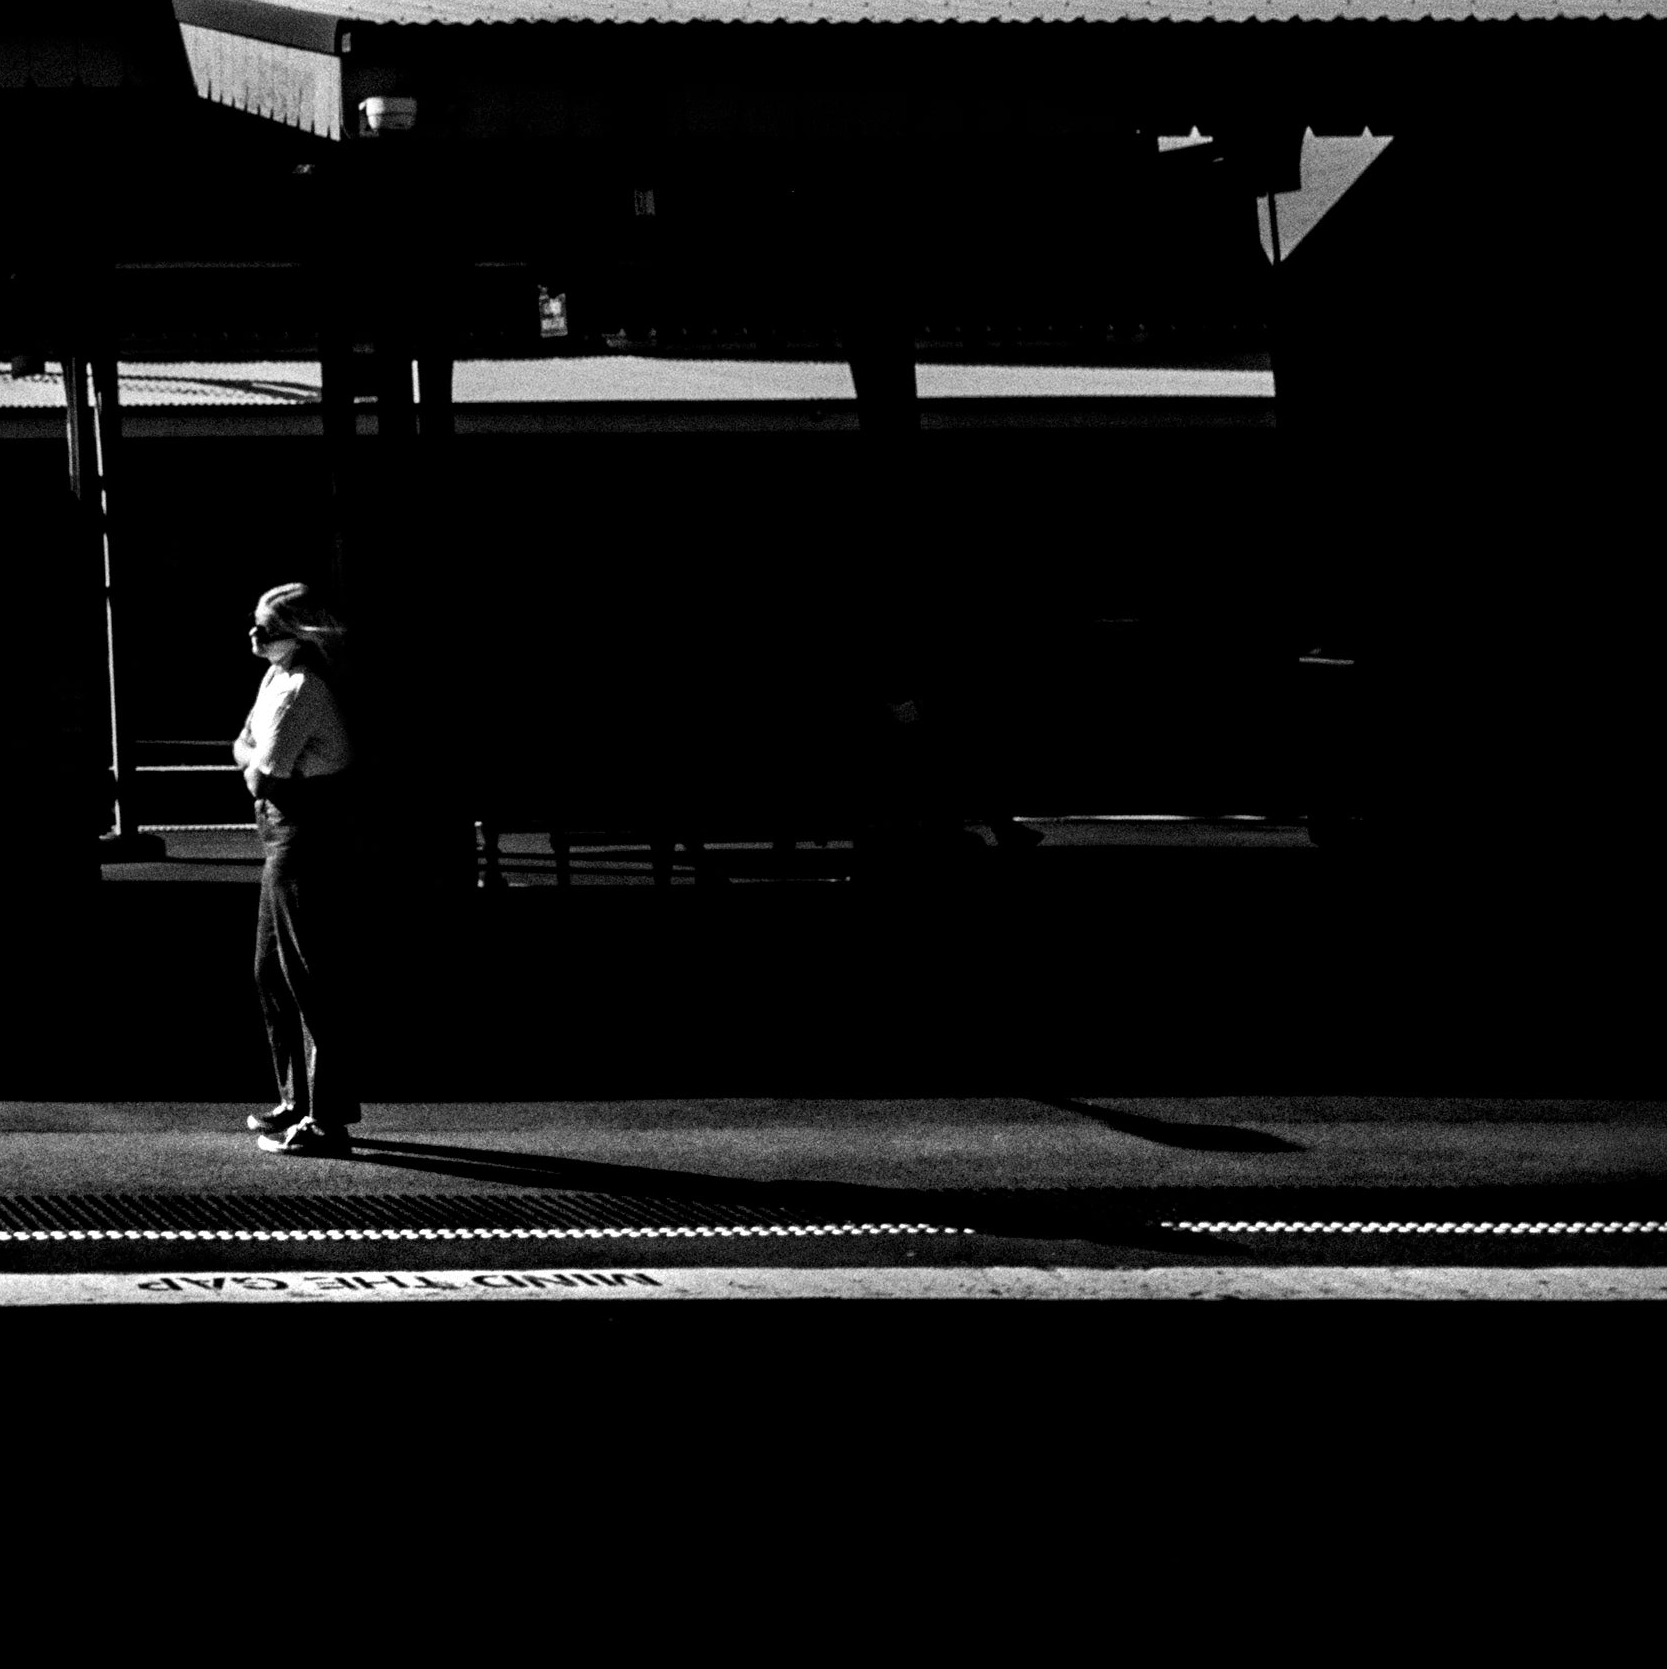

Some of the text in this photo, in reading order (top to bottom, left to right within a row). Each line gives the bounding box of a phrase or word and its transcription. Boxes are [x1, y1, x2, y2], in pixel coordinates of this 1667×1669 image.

[136, 1272, 663, 1292] MIND THE GAP
